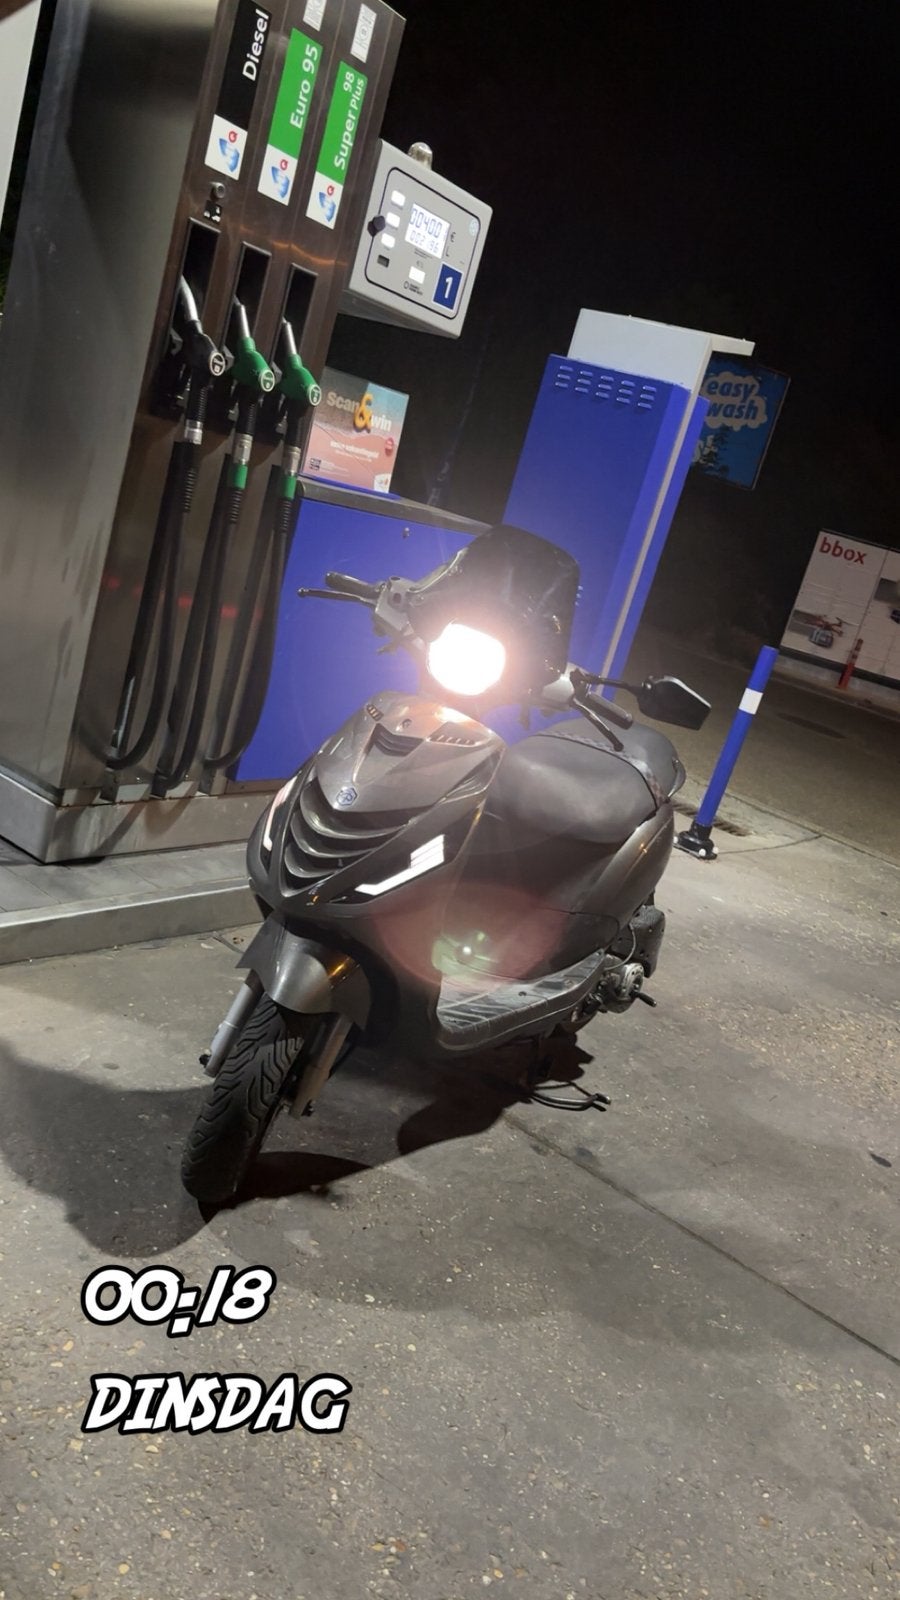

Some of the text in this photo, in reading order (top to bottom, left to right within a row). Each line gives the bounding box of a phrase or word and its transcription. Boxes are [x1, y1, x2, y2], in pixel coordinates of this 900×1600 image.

[242, 8, 269, 81] Diesel
[289, 80, 311, 128] Euro
[302, 44, 319, 74] 95
[343, 71, 355, 92] 98
[334, 109, 356, 170] Super
[350, 78, 365, 110] Plus
[444, 276, 454, 299] 1
[706, 380, 757, 401] easy
[708, 399, 759, 420] wash
[819, 537, 868, 565] bbox
